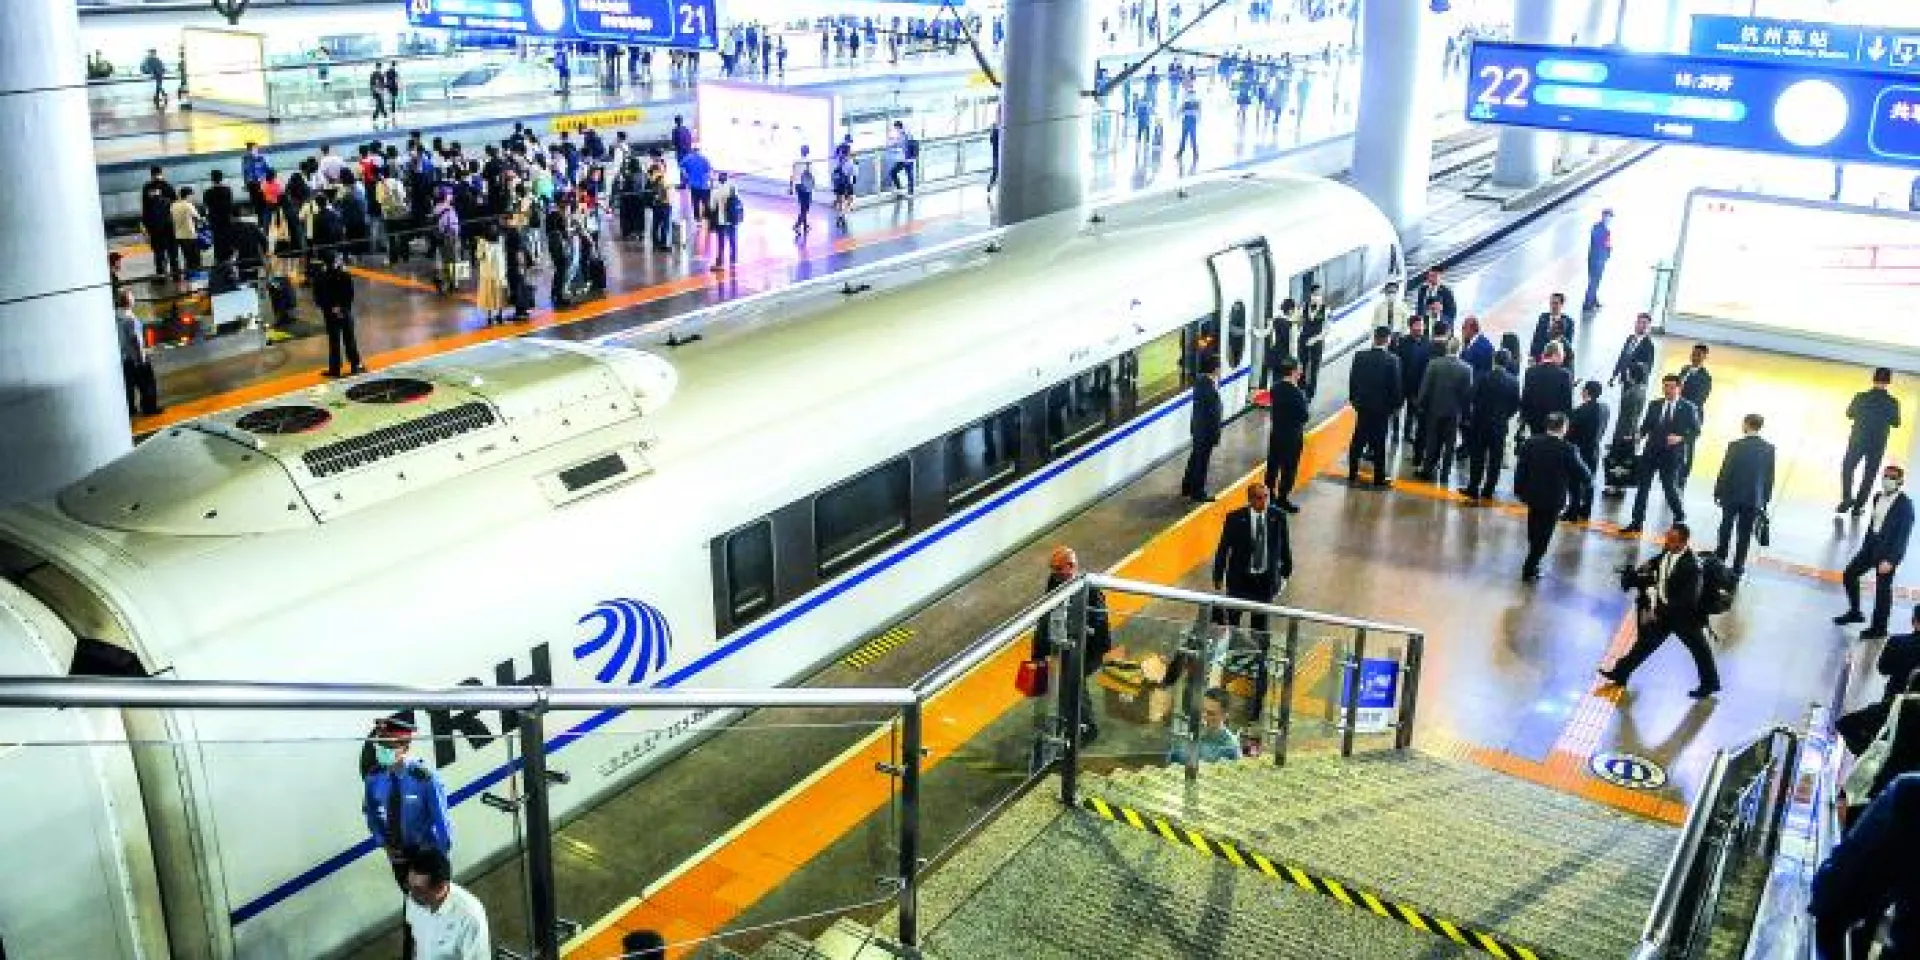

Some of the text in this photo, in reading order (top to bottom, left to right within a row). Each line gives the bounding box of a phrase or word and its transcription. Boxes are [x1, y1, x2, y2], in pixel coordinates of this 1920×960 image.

[680, 4, 706, 34] 21
[1740, 24, 1829, 48] 杭州东站
[1477, 65, 1530, 107] 22
